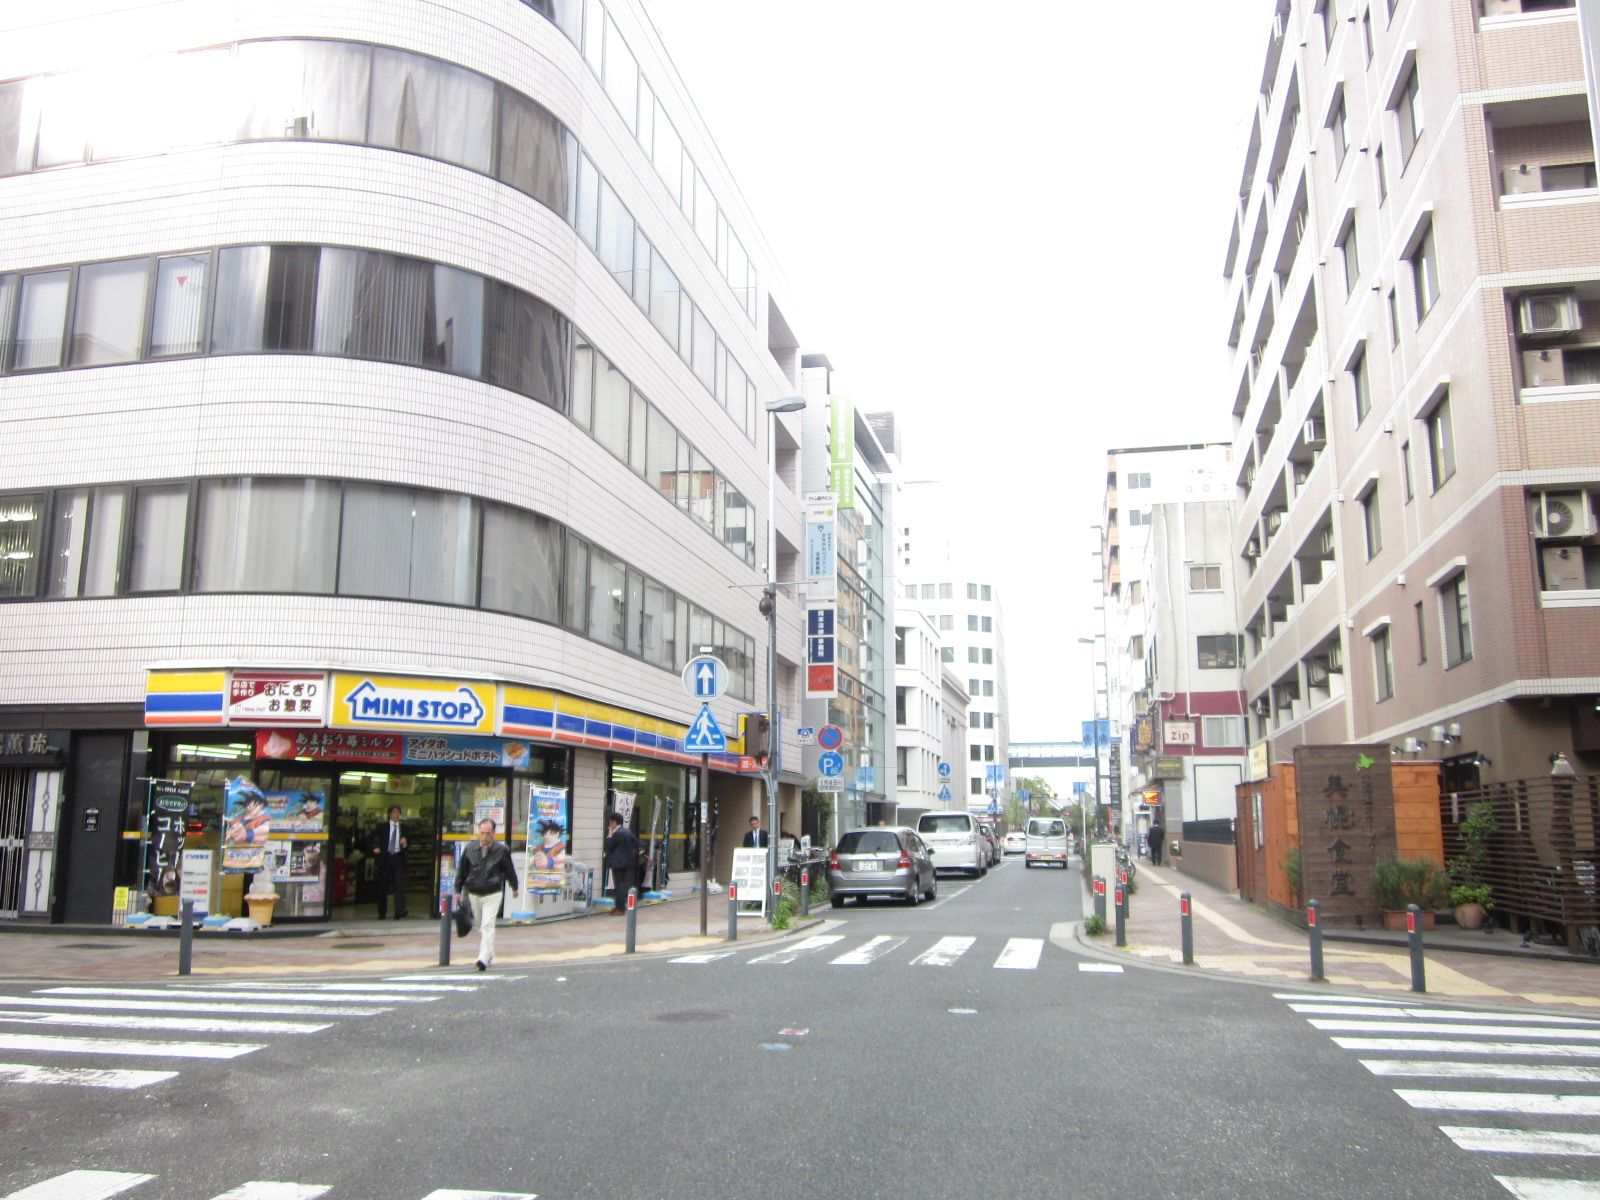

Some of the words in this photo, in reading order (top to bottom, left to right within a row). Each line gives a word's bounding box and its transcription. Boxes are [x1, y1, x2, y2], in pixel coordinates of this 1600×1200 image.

[232, 681, 256, 689] お店で
[264, 683, 317, 697] おにぎり
[232, 689, 255, 697] 手作り
[268, 699, 312, 713] お惣菜
[362, 697, 413, 716] MINI
[417, 700, 472, 719] STOP
[407, 736, 448, 749] アイダホ
[296, 746, 328, 756] ソフト
[407, 748, 499, 763] ミニハッシュドポテト
[823, 758, 834, 775] P
[156, 817, 171, 882] コーヒー
